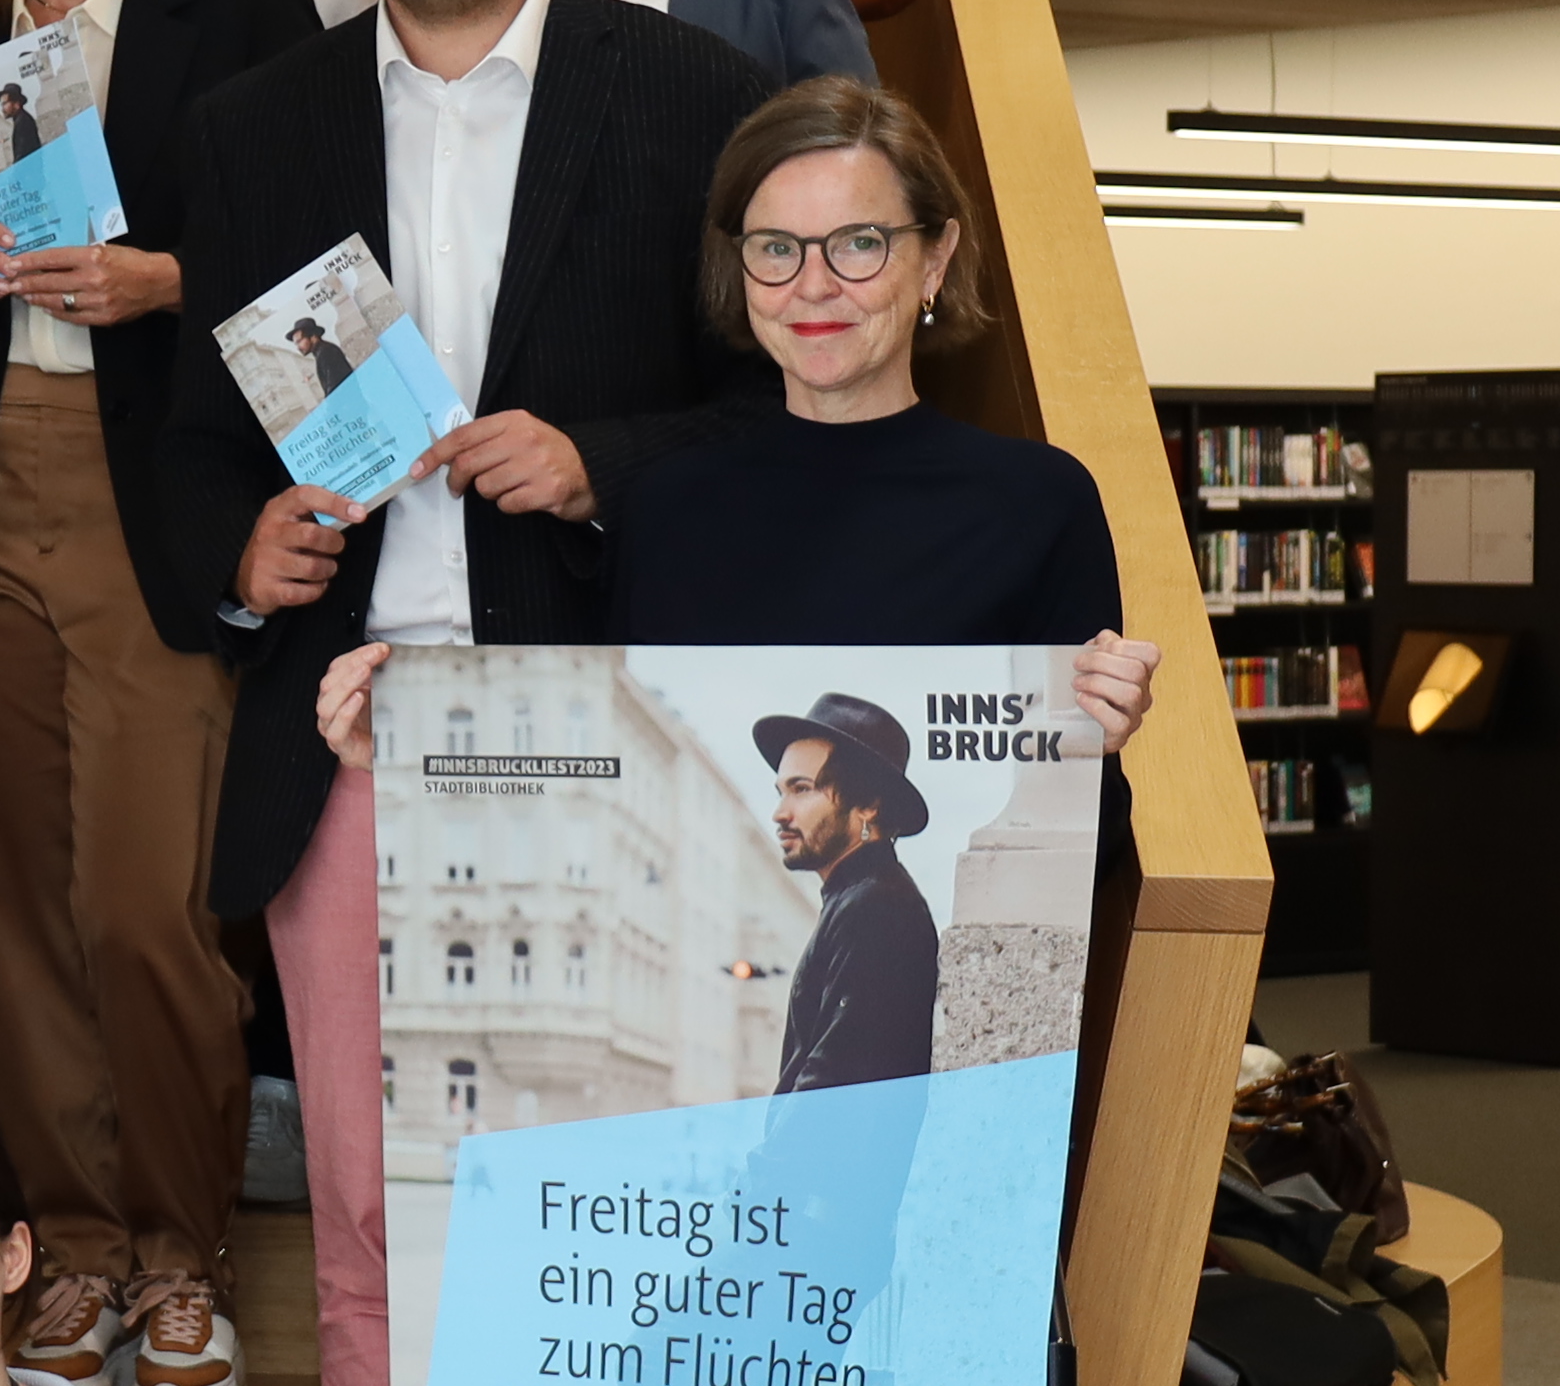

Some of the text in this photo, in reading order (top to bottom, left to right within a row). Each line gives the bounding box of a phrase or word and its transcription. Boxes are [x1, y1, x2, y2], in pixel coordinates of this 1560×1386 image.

[288, 425, 328, 456] Freitag
[927, 730, 1062, 762] BRUCK
[428, 757, 616, 776] #INNSBRUCKLIEST2023
[424, 781, 545, 795] STADTBIBLIOTHEK
[540, 1181, 789, 1257] Freitag ist
[540, 1252, 857, 1344] ein guter Tag
[539, 1337, 642, 1384] zum
